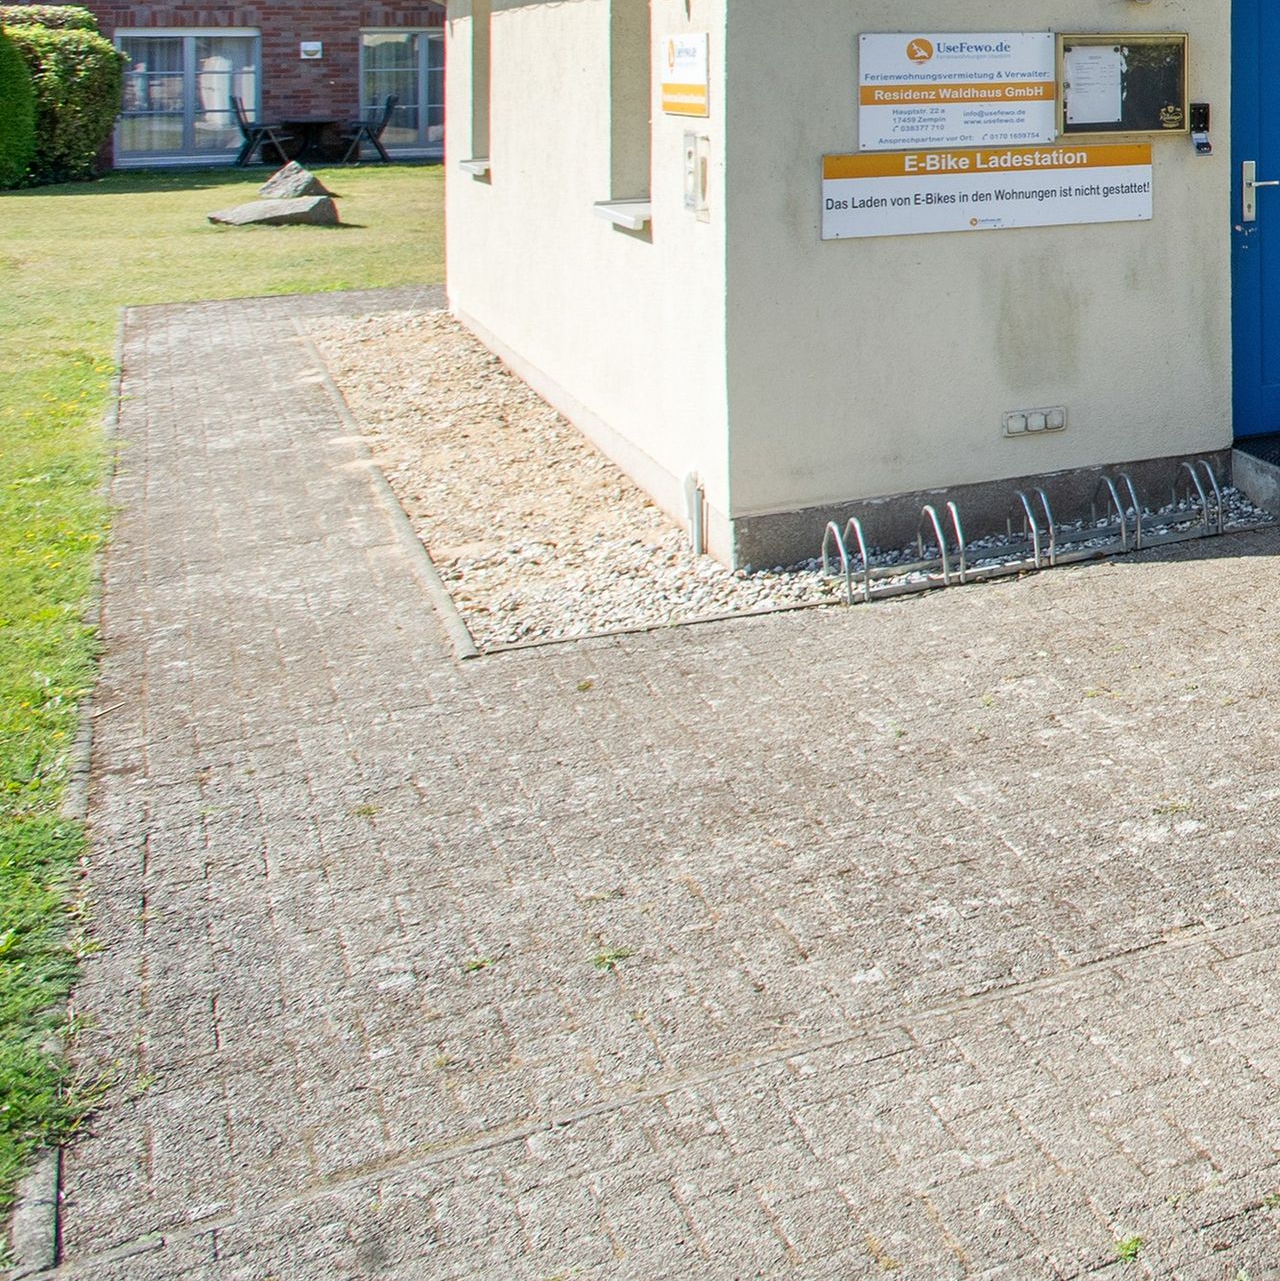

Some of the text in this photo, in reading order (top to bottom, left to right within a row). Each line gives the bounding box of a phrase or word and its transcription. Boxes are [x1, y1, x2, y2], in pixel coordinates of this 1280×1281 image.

[937, 42, 1010, 53] UseFewo.de
[865, 72, 994, 81] Ferienwohnungsvermietung
[875, 87, 1043, 100] Residenz Waldhaus GmbH
[879, 136, 944, 145] Ansprechpartner
[904, 150, 1087, 171] E-Bike Ladestation
[826, 182, 1150, 210] Das Laden von E-Bikes in den Wohnungen ist nicht gestattet!
